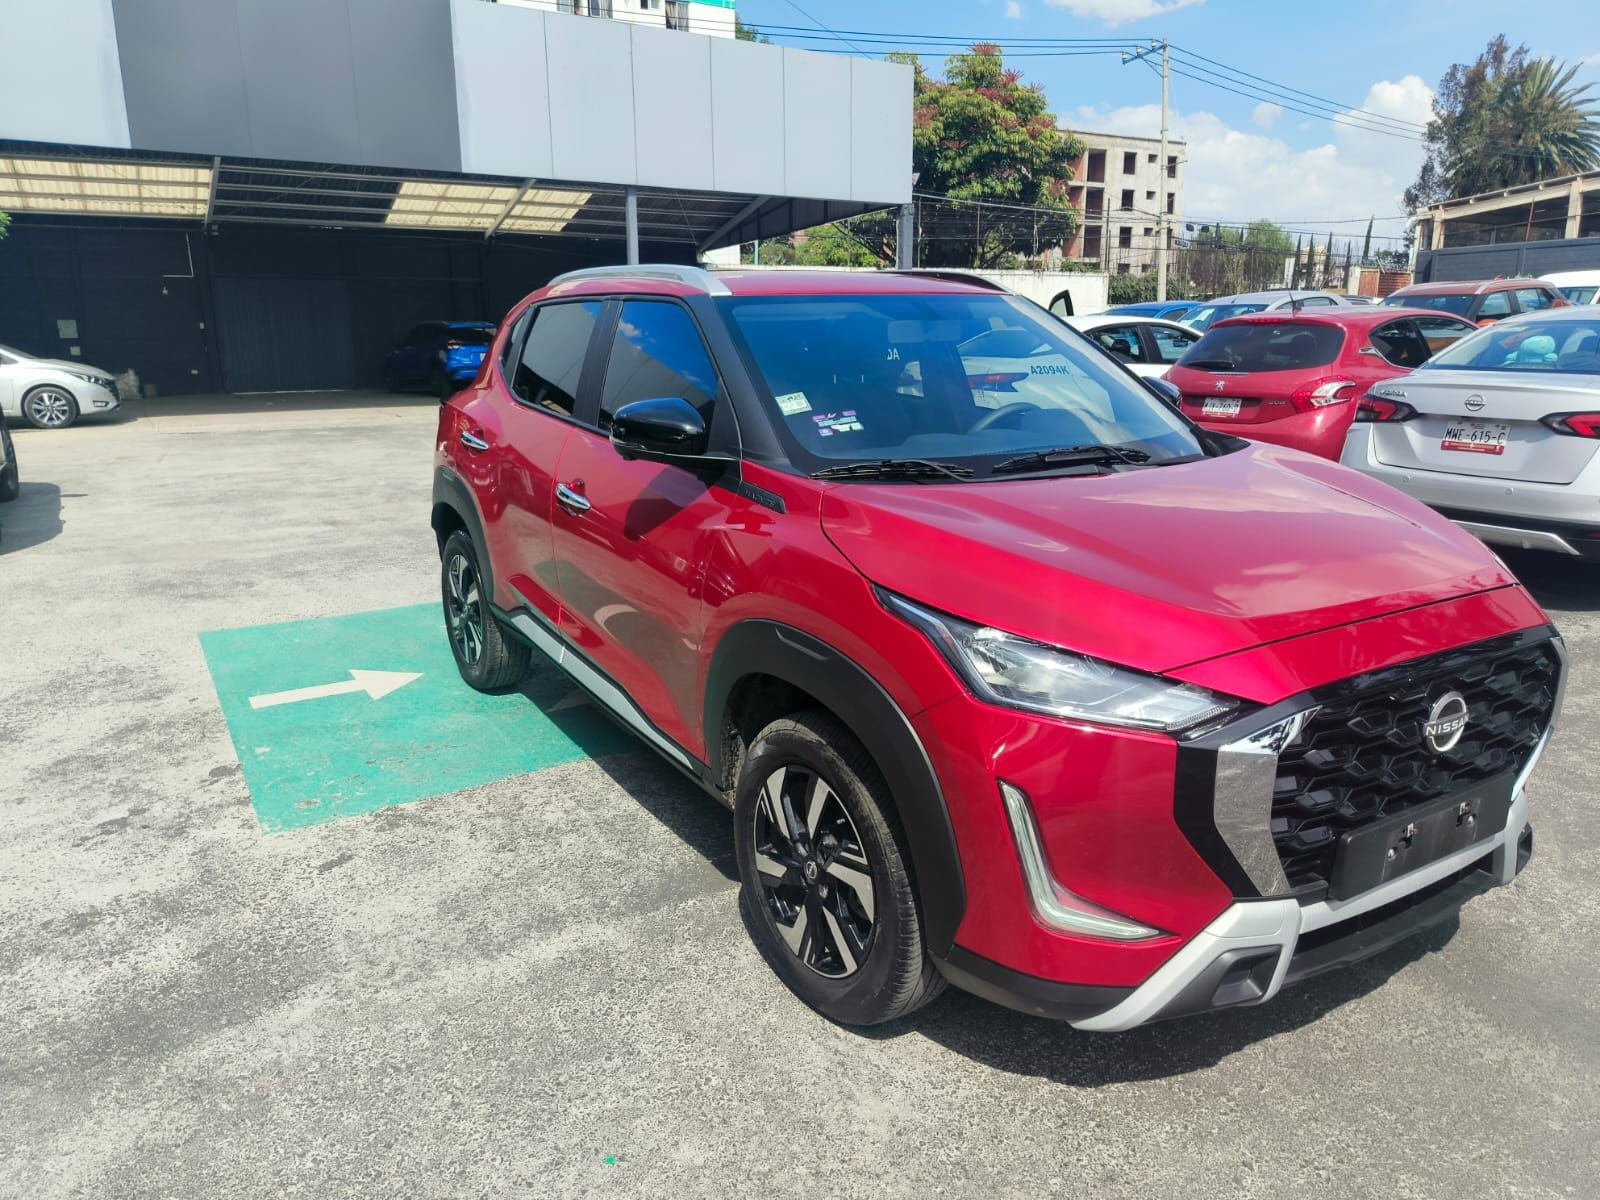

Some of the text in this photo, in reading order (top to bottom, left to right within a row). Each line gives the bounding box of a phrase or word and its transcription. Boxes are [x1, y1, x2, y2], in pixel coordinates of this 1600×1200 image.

[1030, 365, 1070, 375] A2094K
[1445, 427, 1506, 445] MWE-615-C
[1425, 716, 1467, 736] NISSA
